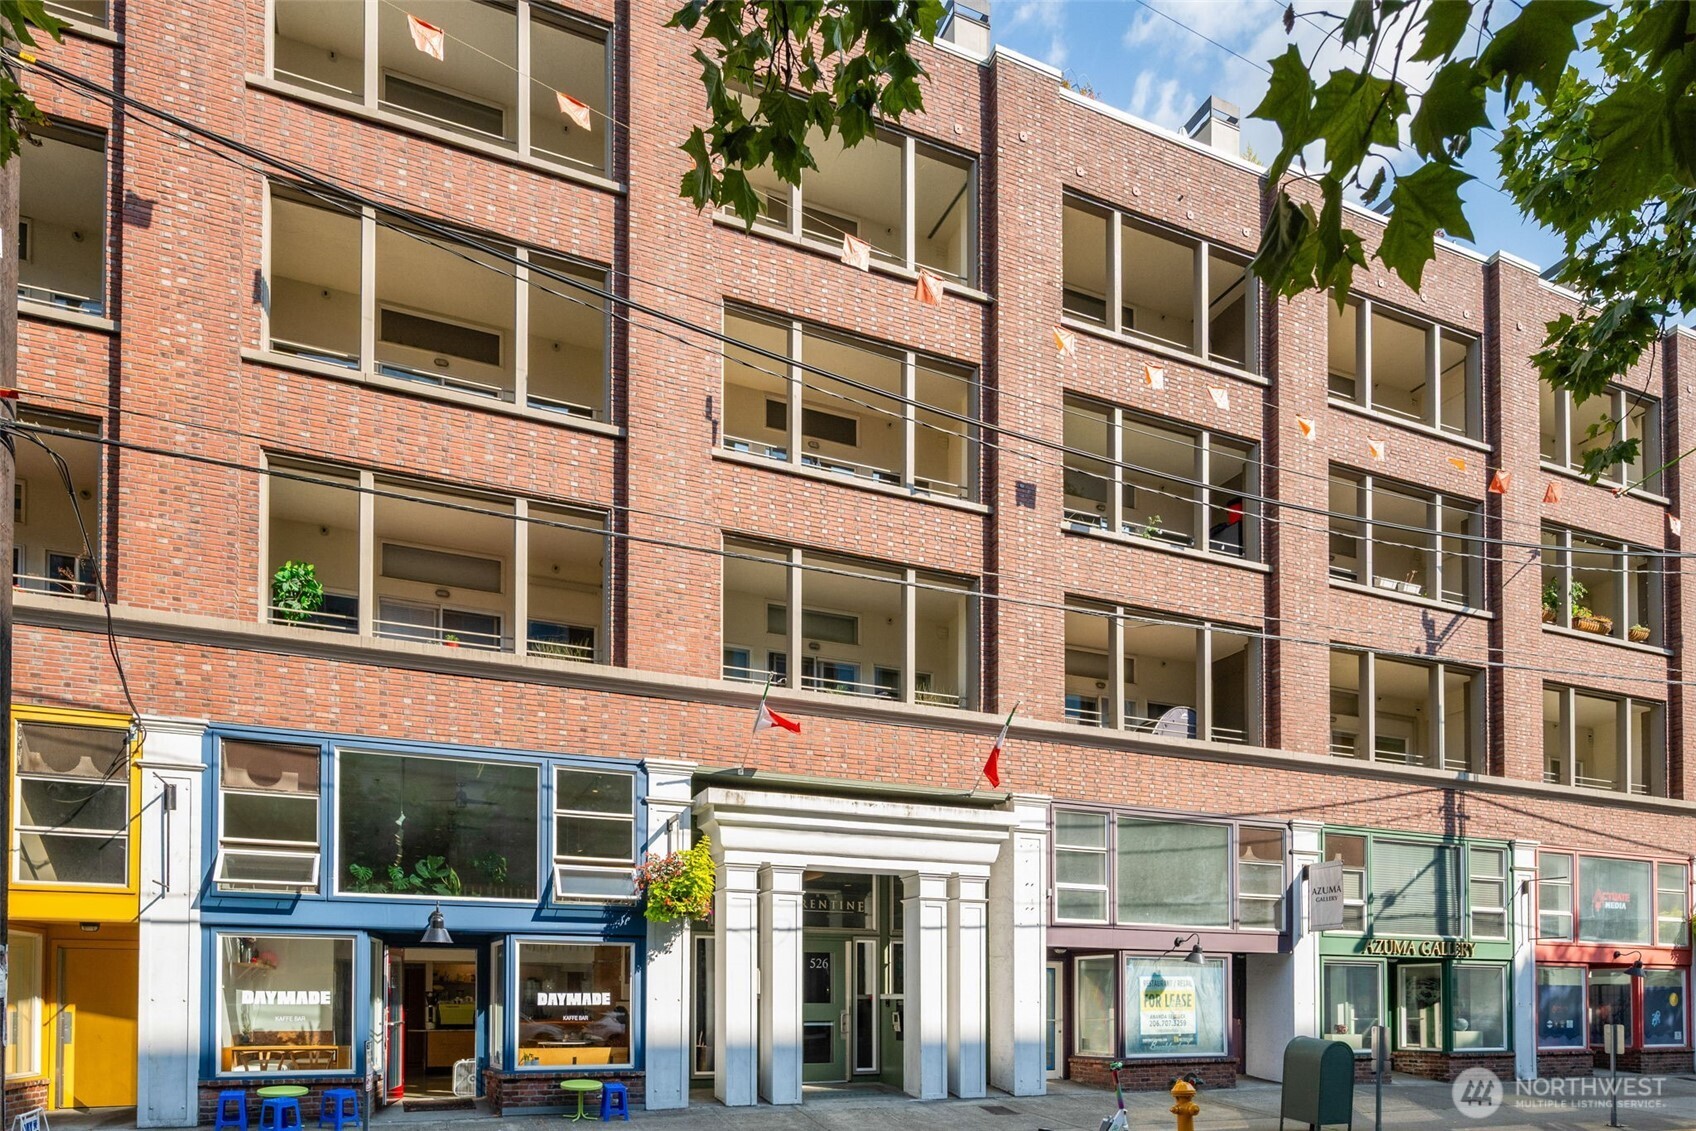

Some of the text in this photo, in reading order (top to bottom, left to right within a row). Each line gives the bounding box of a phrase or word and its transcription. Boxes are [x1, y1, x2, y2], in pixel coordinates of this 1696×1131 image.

[1312, 885, 1342, 895] AZUMA
[1605, 902, 1626, 910] MEDIA
[1362, 939, 1417, 955] AZUMA
[1420, 940, 1477, 957] GALLERY
[810, 958, 828, 968] 526
[242, 990, 330, 1004] DAYMADE
[537, 992, 610, 1006] DAYMADE
[1144, 994, 1192, 1008] FOR LEASE
